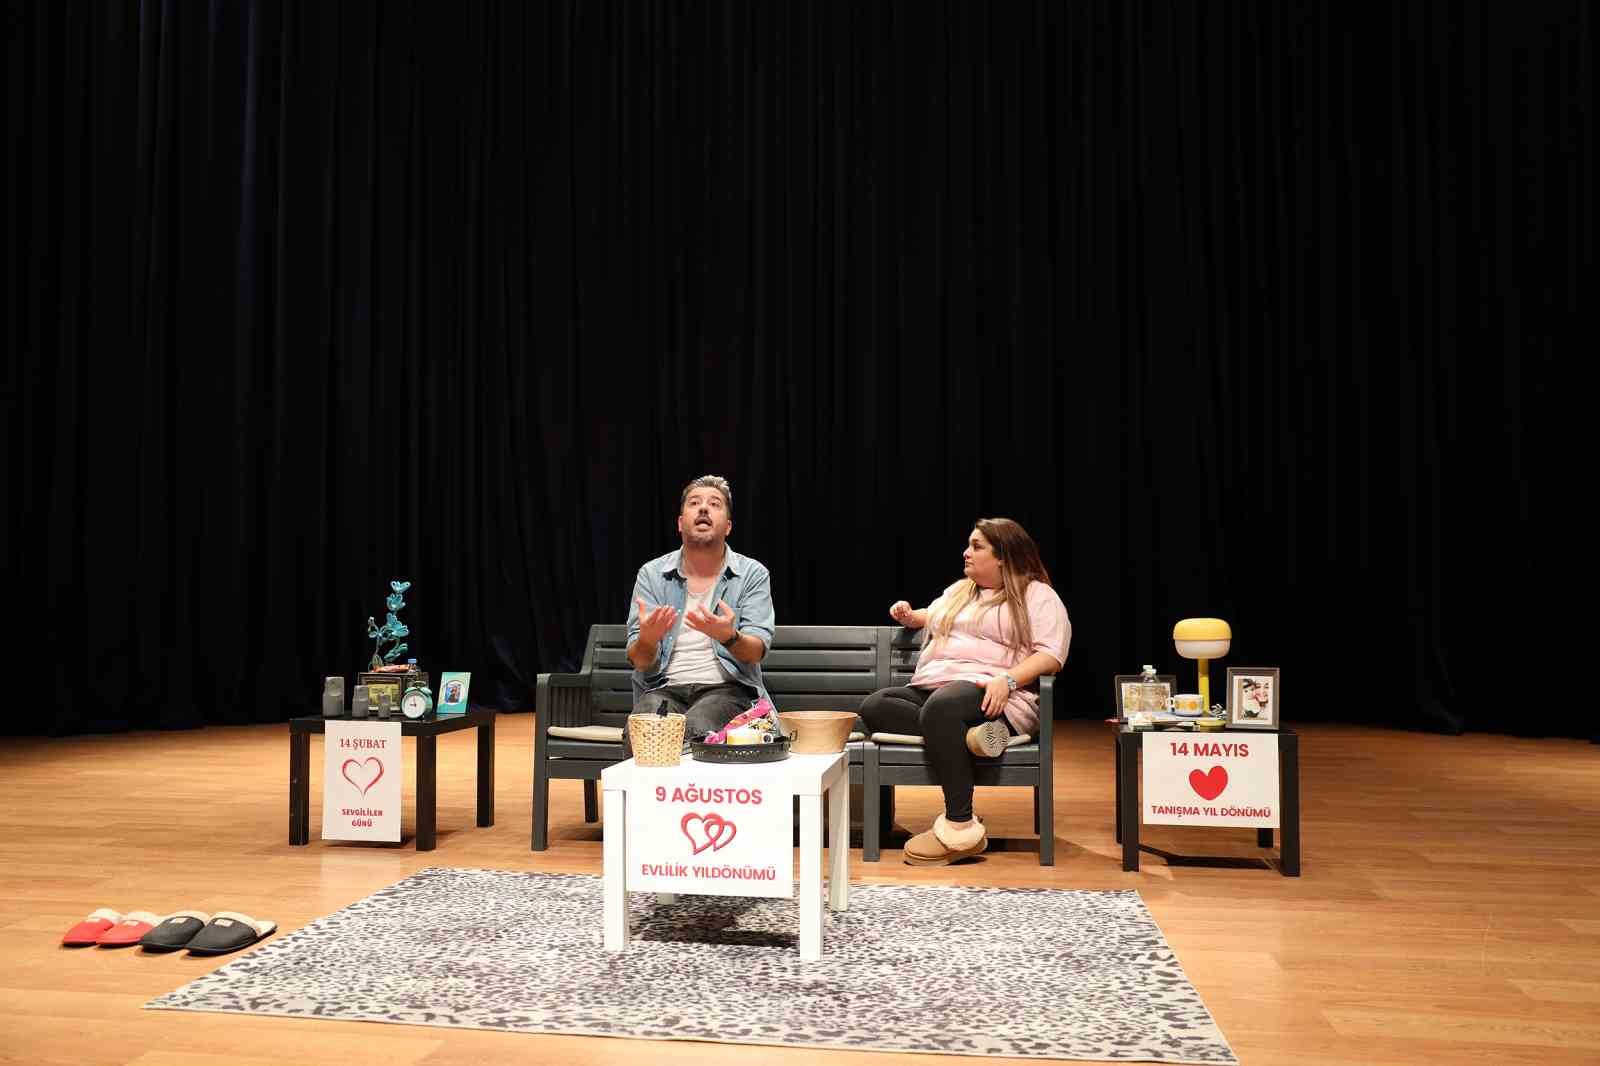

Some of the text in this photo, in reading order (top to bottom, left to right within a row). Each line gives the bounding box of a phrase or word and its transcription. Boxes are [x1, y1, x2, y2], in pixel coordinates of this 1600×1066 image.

[340, 738, 386, 750] 14 ŞUBAT
[1170, 742, 1249, 757] 14 MAYIS
[656, 783, 763, 805] 9 AĞUSTOS
[342, 807, 383, 817] SEVGİLİLER
[1151, 805, 1271, 818] TANIŞMA YIL DÖNÜMÜ
[351, 818, 373, 828] GÜNÜ
[641, 862, 776, 881] EVLİLİK YILDÖNÜMÜ
